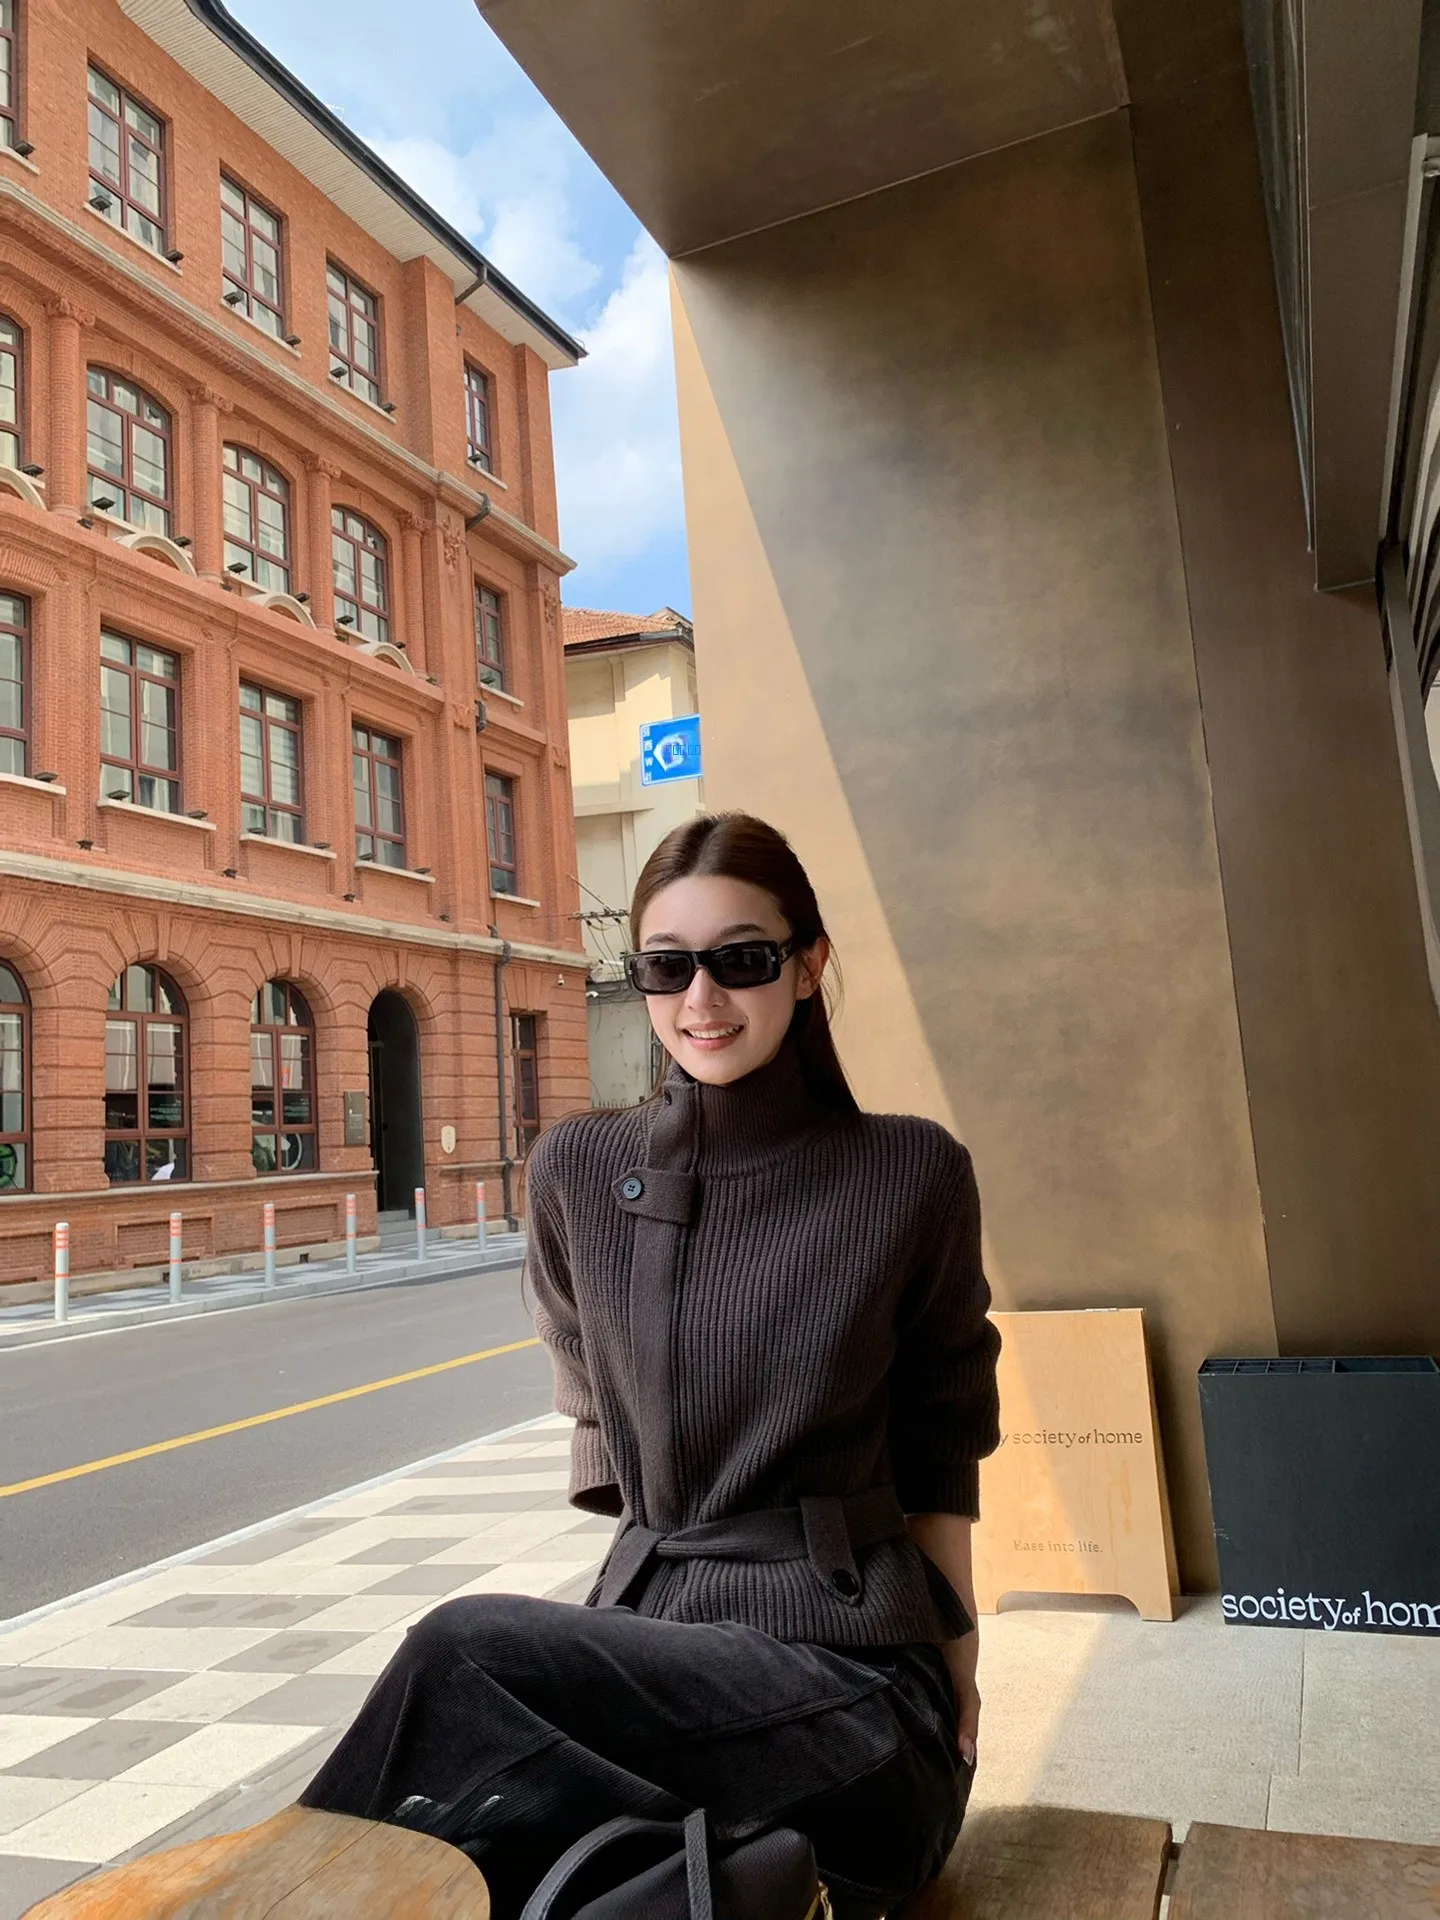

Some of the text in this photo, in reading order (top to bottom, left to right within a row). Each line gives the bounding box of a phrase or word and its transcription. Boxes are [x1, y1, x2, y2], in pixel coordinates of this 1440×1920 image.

[1012, 1430, 1076, 1447] society
[1078, 1433, 1091, 1444] of
[1094, 1429, 1143, 1444] home
[1013, 1539, 1103, 1553] Ease into life.
[1221, 1588, 1346, 1631] society
[1341, 1607, 1361, 1625] of
